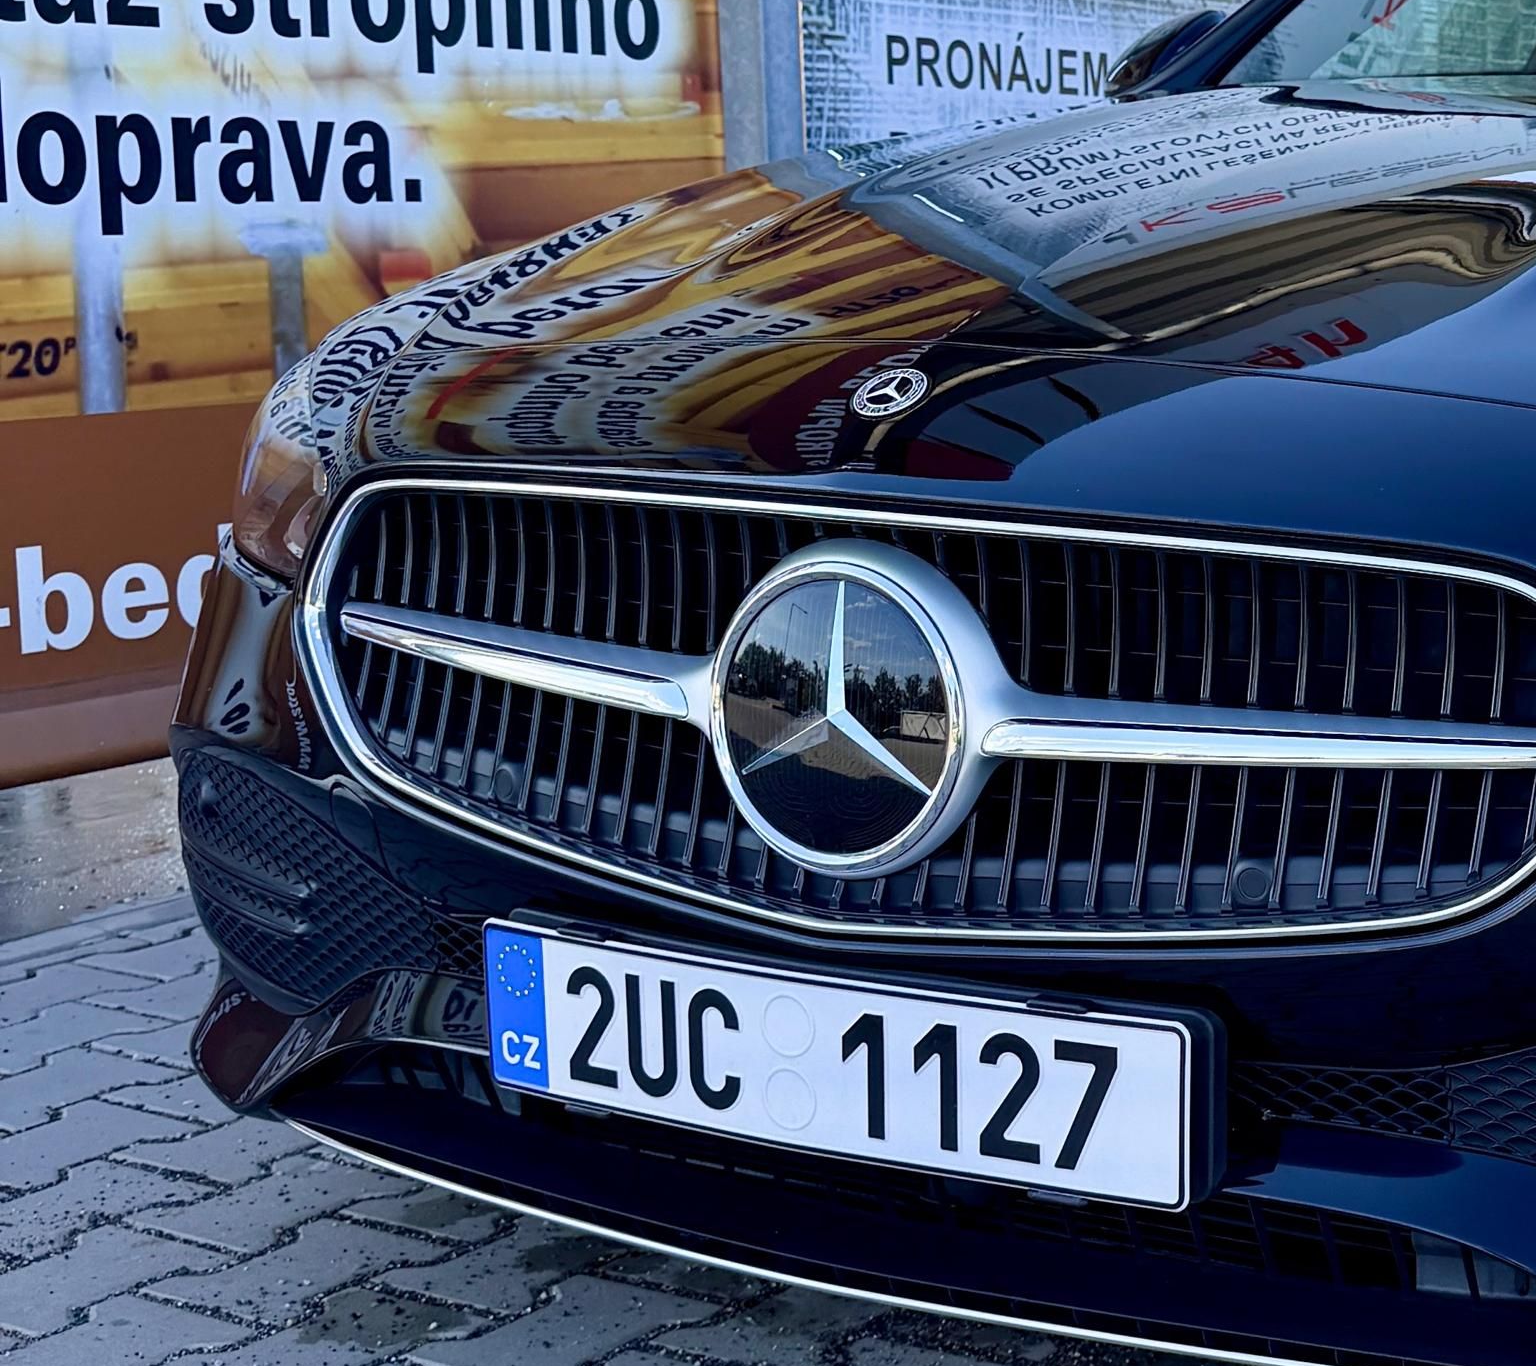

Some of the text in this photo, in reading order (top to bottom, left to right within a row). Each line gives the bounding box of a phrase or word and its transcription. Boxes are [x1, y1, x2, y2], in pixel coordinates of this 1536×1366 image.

[886, 32, 1108, 97] PRONÁJEM
[0, 75, 424, 236] oprava.
[501, 1030, 541, 1071] CZ
[566, 965, 1119, 1171] 2UC 1127
